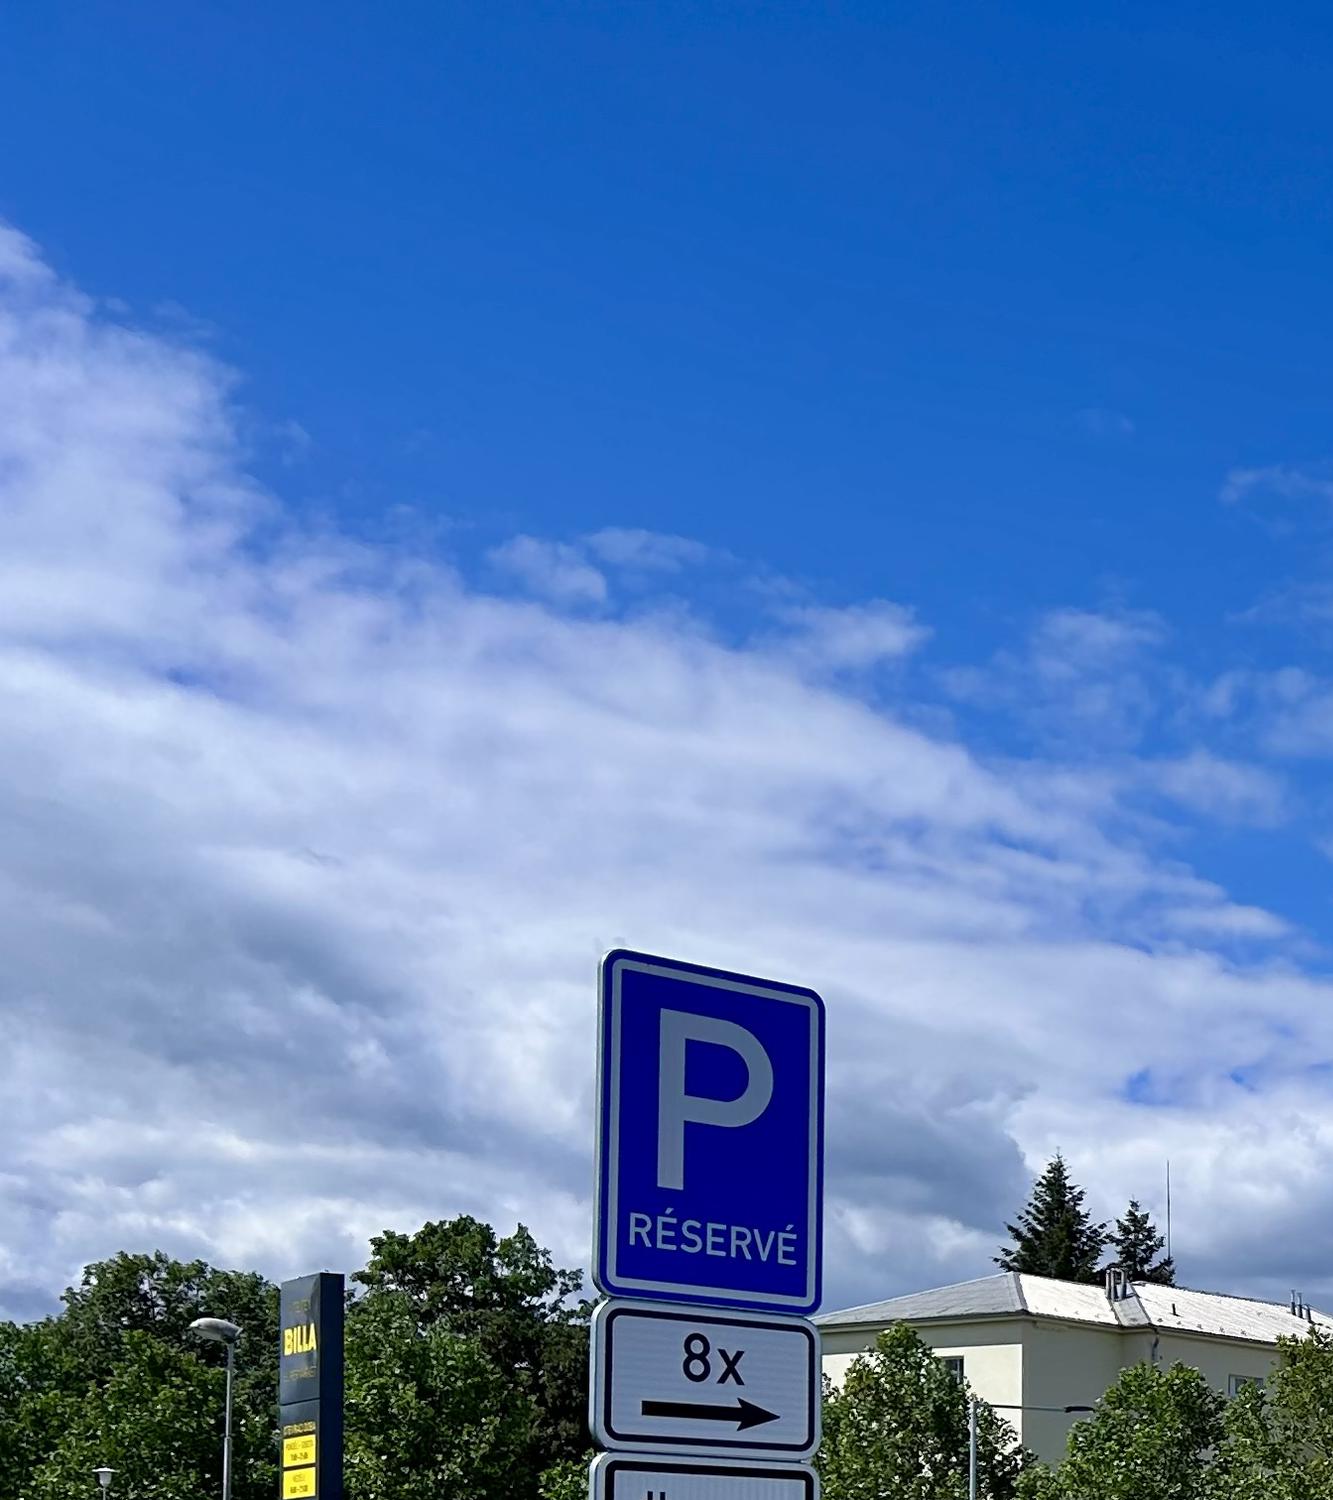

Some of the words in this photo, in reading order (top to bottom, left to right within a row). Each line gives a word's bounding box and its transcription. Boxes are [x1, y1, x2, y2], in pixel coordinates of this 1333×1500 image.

[656, 1007, 774, 1191] P
[628, 1207, 798, 1266] RÉSERVÉ
[283, 1322, 317, 1357] BILLA
[682, 1332, 746, 1386] 8x
